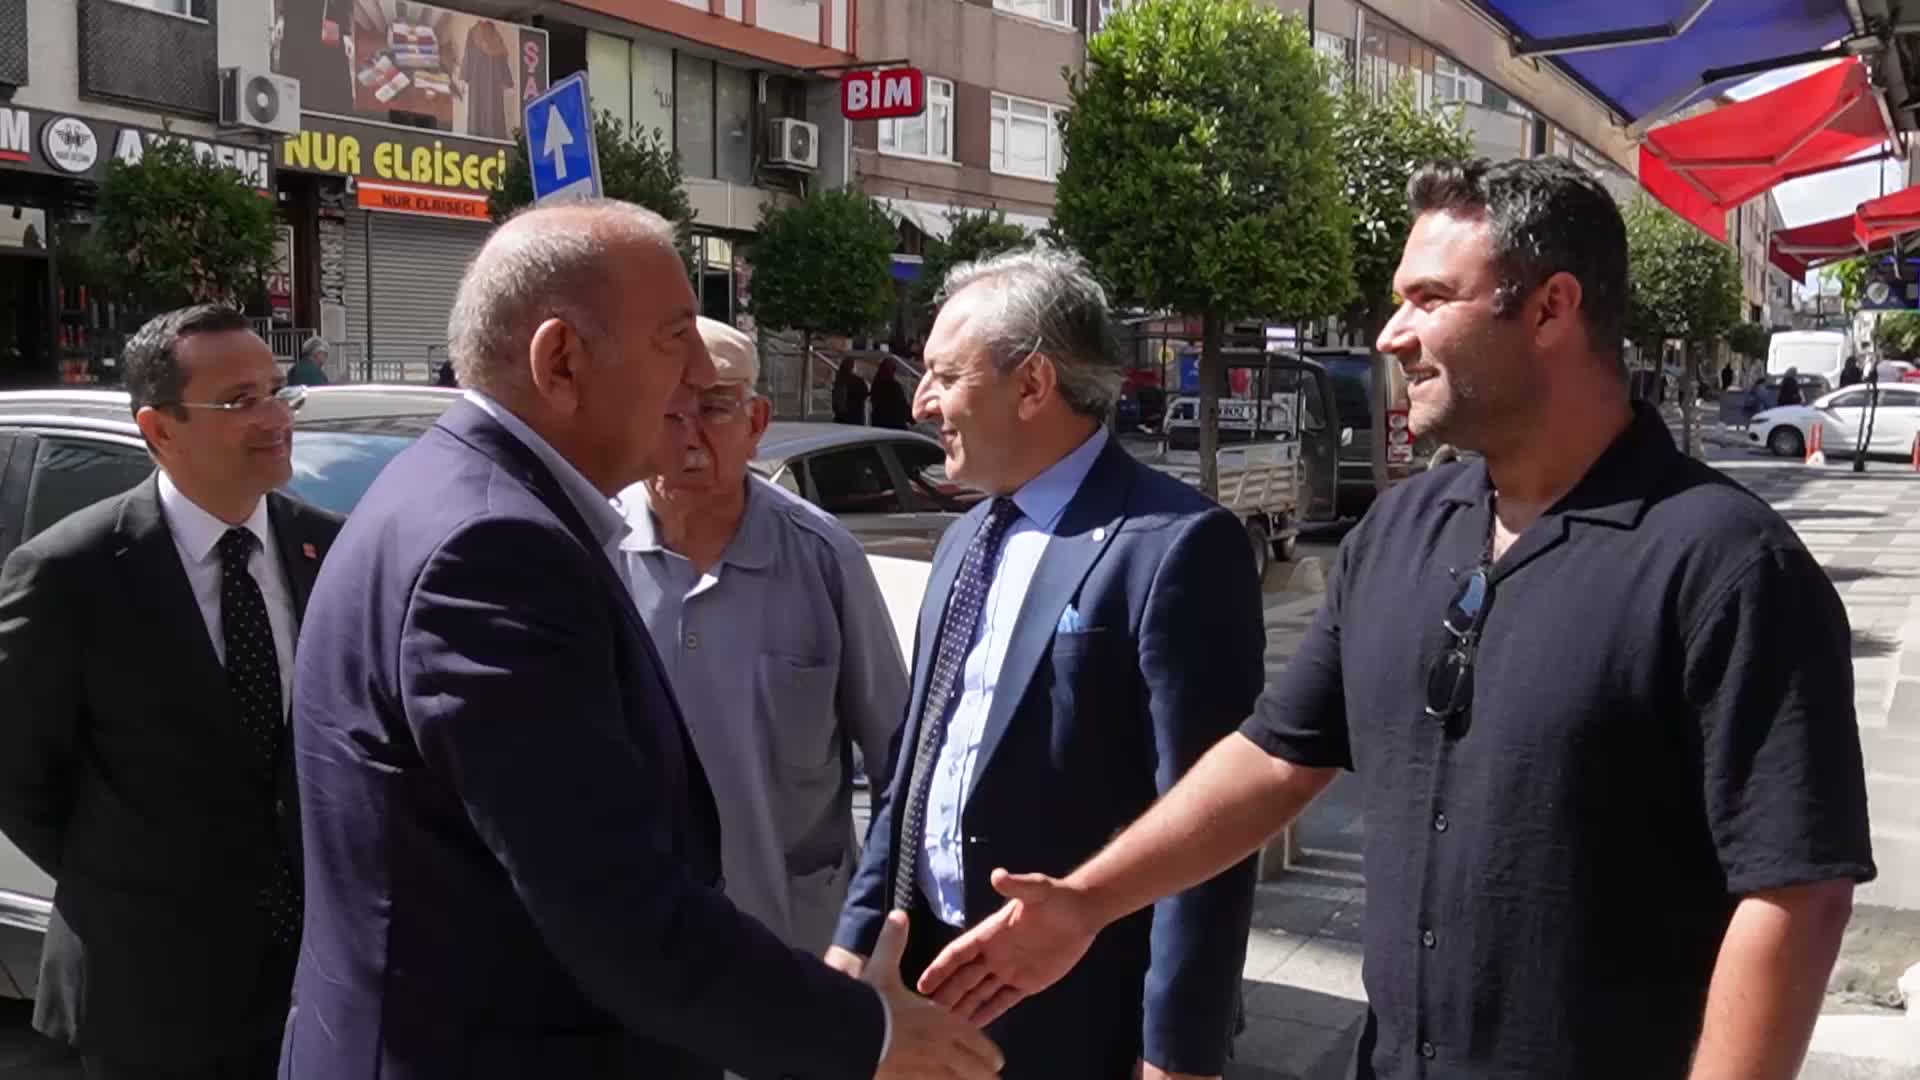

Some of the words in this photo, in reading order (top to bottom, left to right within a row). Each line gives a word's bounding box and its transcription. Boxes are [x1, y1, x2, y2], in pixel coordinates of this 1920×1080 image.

[847, 70, 912, 111] BİM
[284, 130, 361, 175] NUR
[383, 193, 410, 209] NUR
